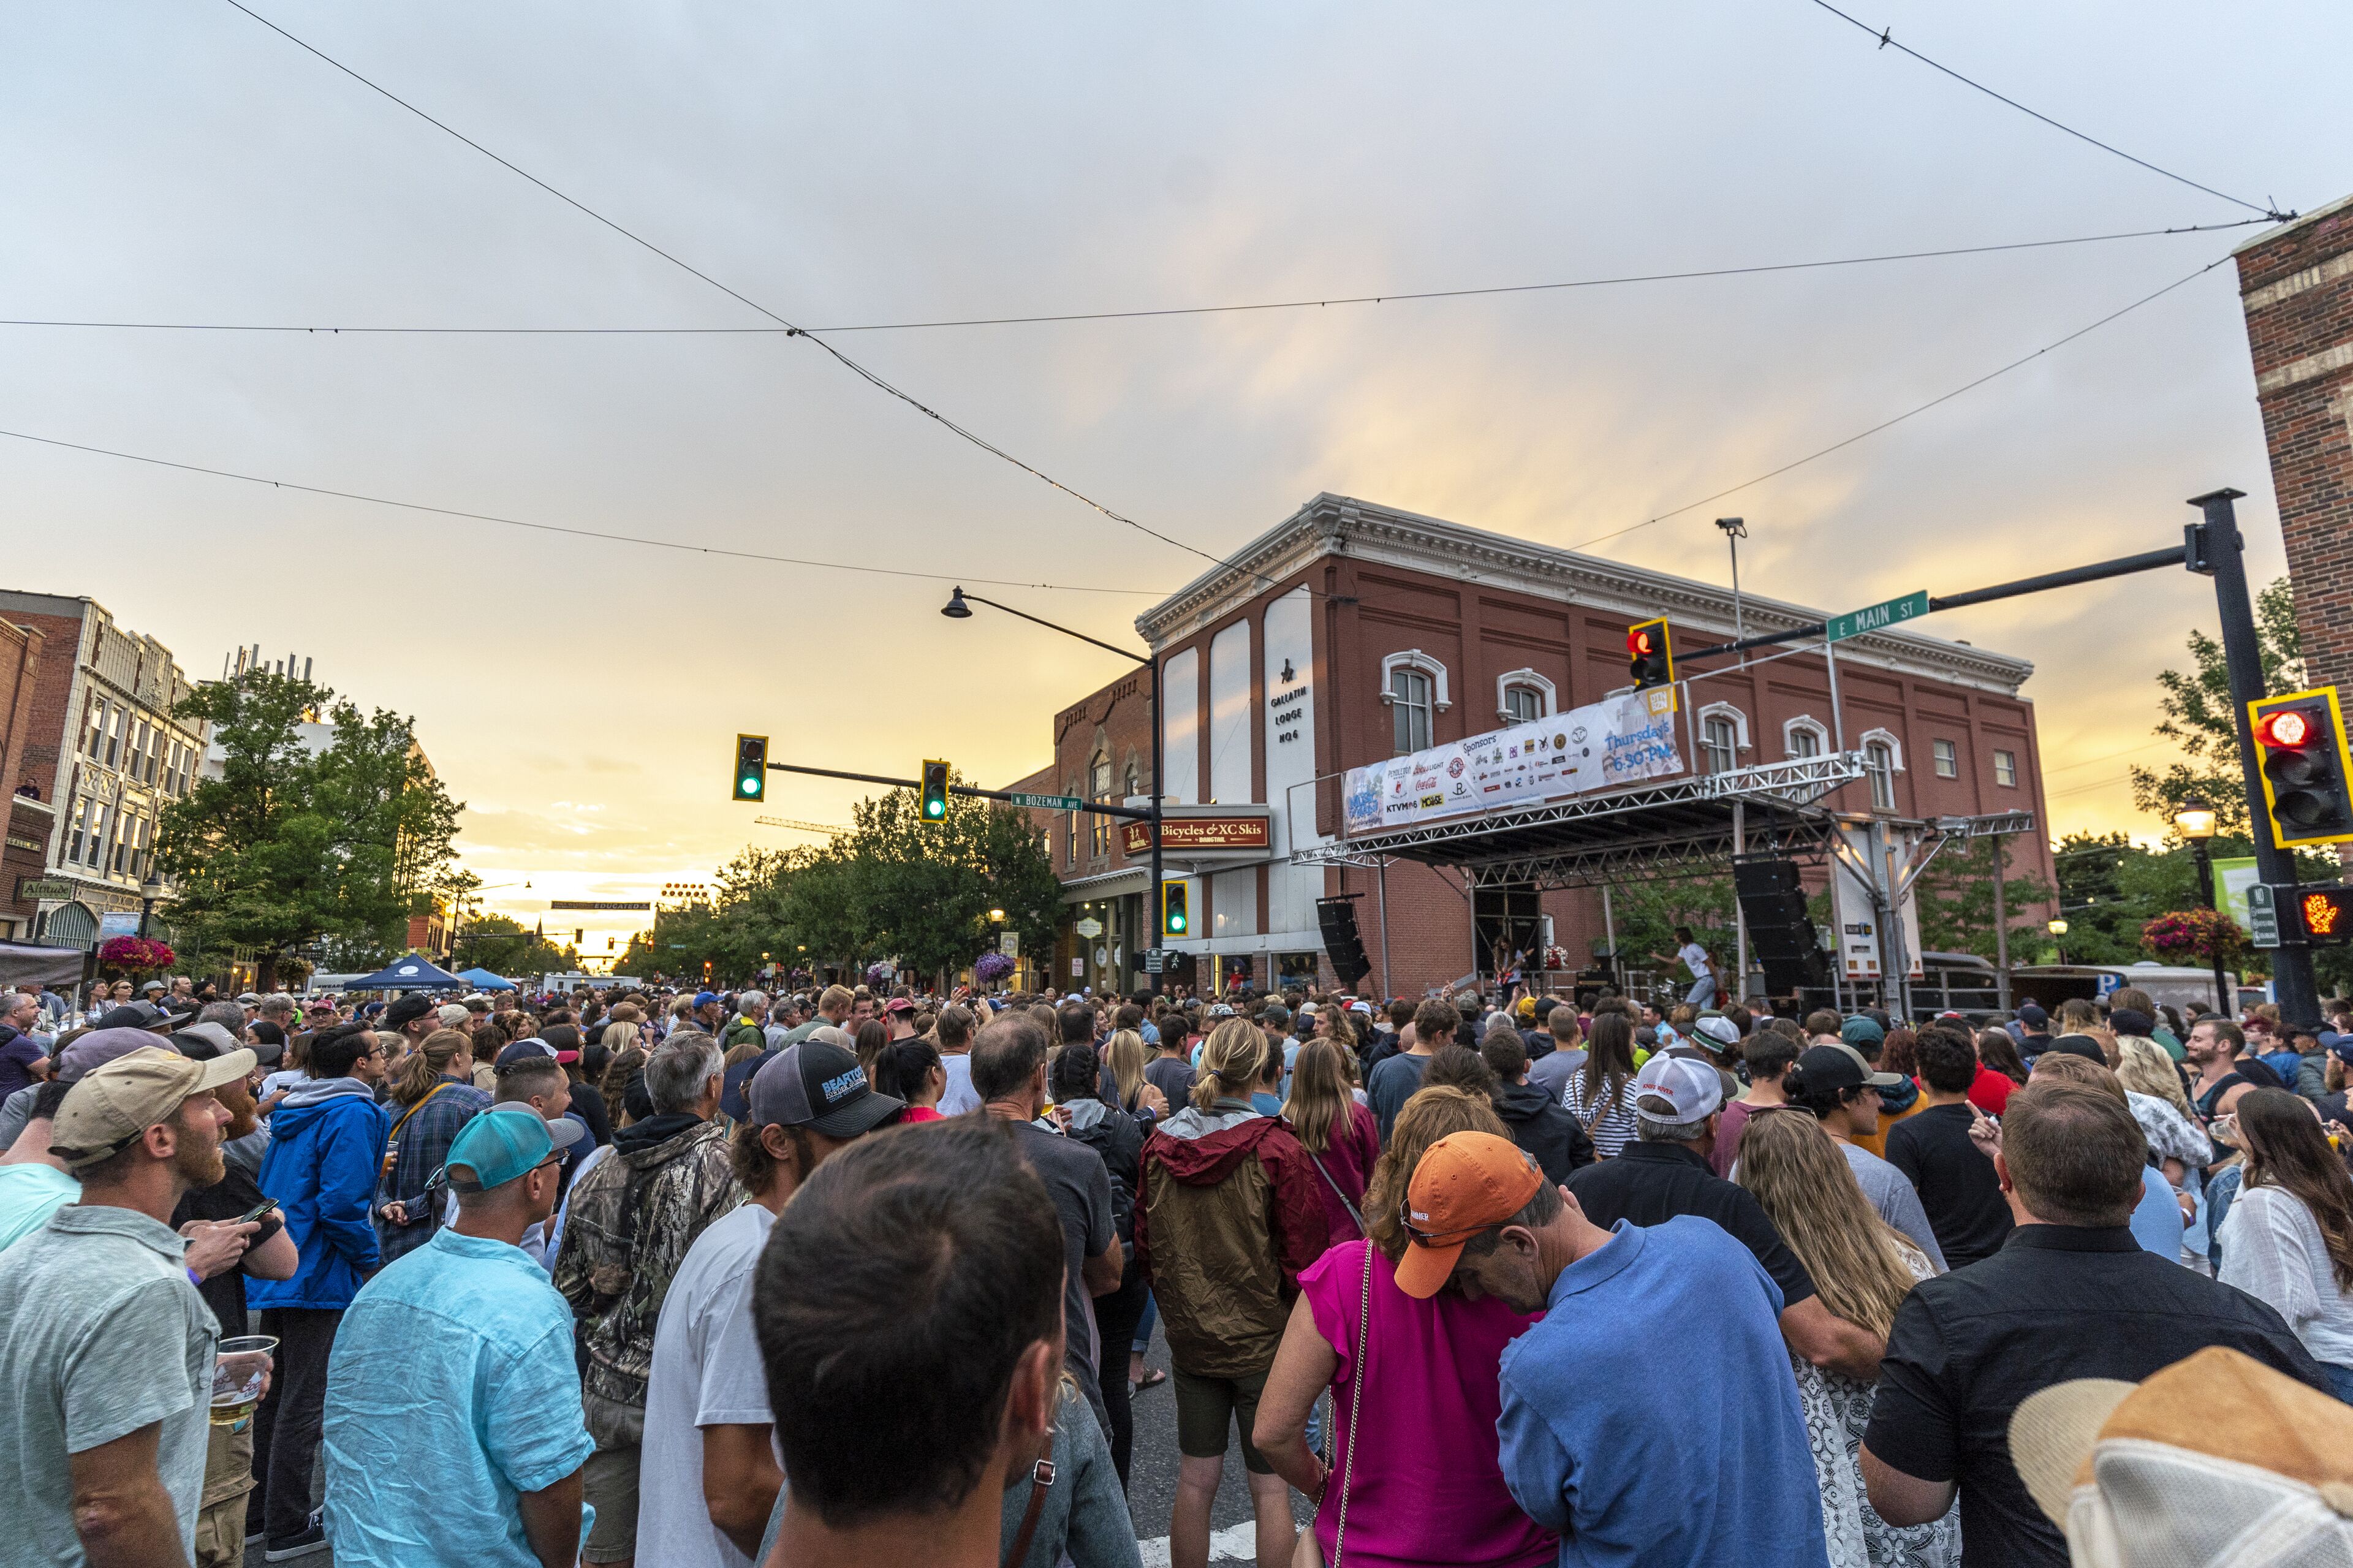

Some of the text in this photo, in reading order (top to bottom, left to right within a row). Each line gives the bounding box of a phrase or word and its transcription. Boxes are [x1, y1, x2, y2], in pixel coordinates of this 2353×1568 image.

[1840, 602, 1913, 636] E MAIN ST
[1271, 686, 1306, 707] GALLATIN
[1275, 708, 1302, 725] LODGE
[1463, 735, 1497, 756] Sponsors
[1613, 743, 1672, 771] 6:30 PM
[1388, 766, 1411, 778] PENDLETON
[1429, 762, 1444, 771] LIGHT
[1026, 795, 1062, 808] BOZEMAN
[1387, 803, 1409, 812] KTVM
[1160, 823, 1261, 838] Bicycles & XC Skis
[25, 883, 69, 894] Altitude
[2098, 974, 2116, 996] P
[825, 1085, 849, 1099] POWDER
[1656, 1085, 1674, 1096] RIVER
